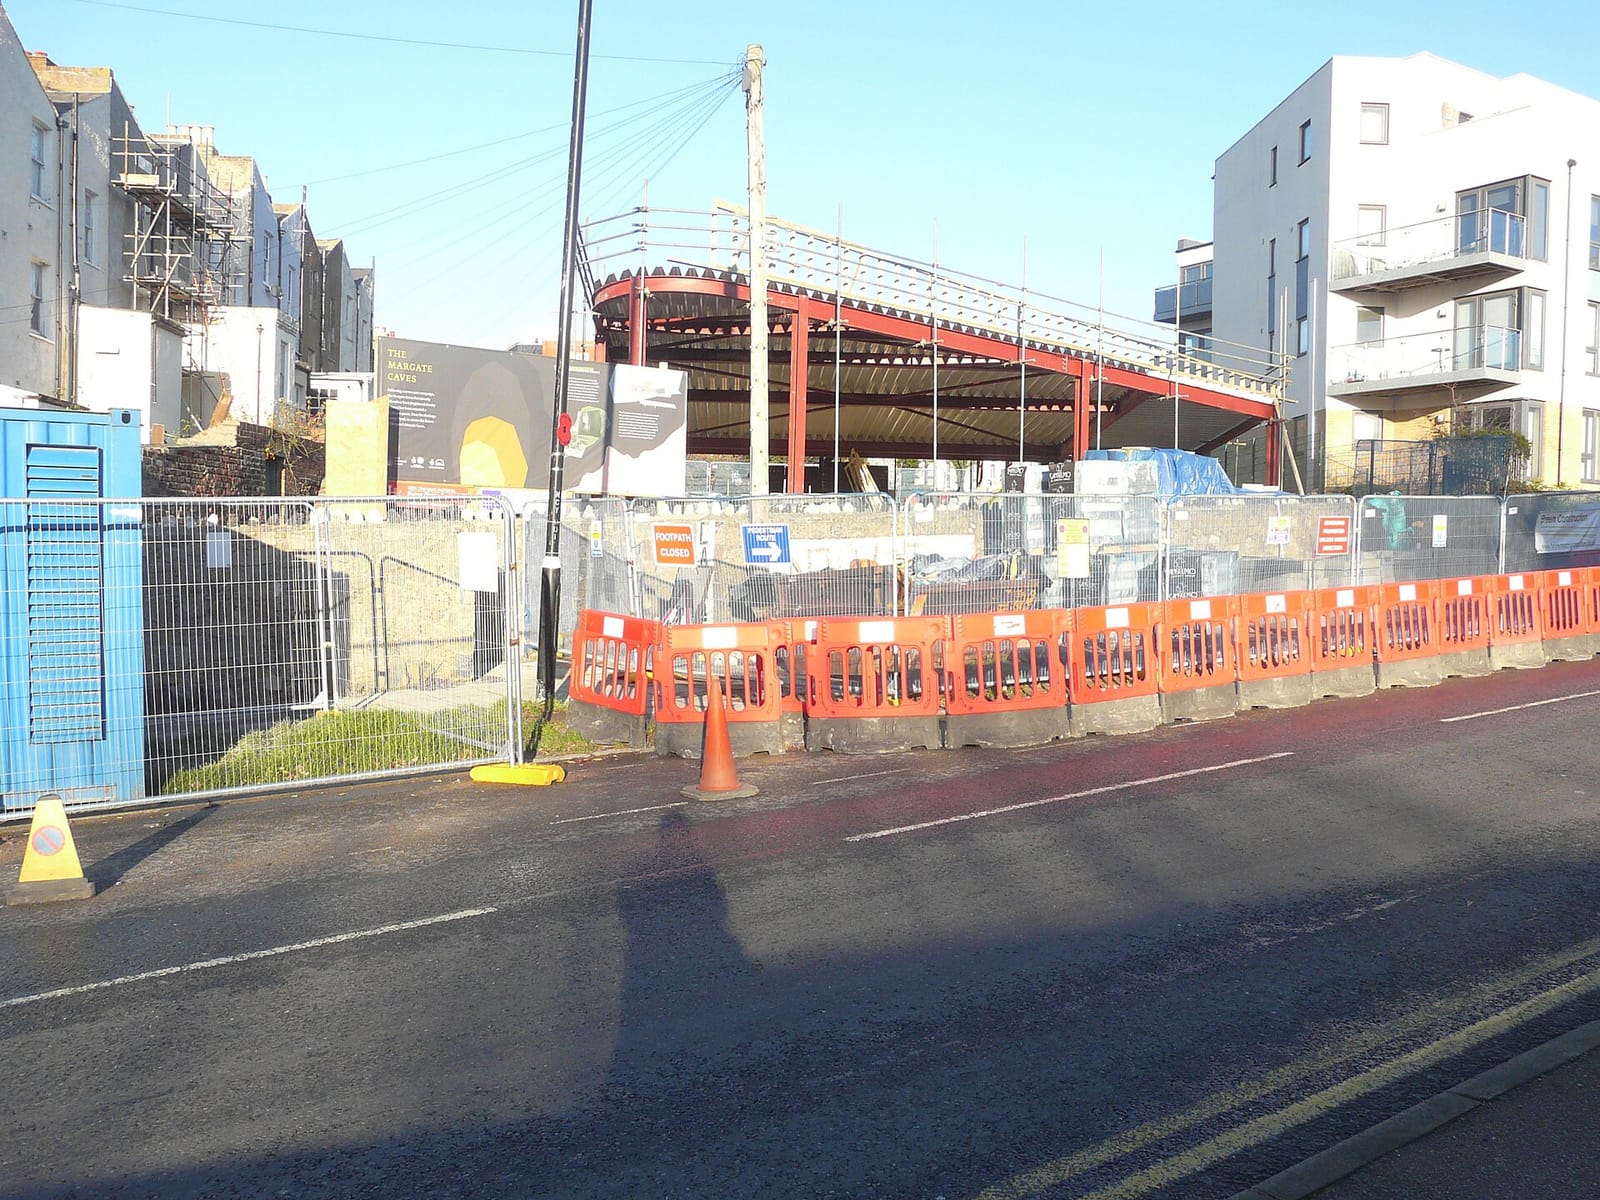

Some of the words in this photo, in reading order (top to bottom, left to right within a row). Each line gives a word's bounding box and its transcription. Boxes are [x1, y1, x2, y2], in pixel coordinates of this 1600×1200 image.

[387, 348, 407, 359] THE
[387, 360, 433, 373] MARGATE
[387, 372, 417, 383] CAVES
[655, 532, 692, 542] FOOTPATH
[756, 534, 776, 542] ROUTE
[660, 547, 690, 557] CLOSED
